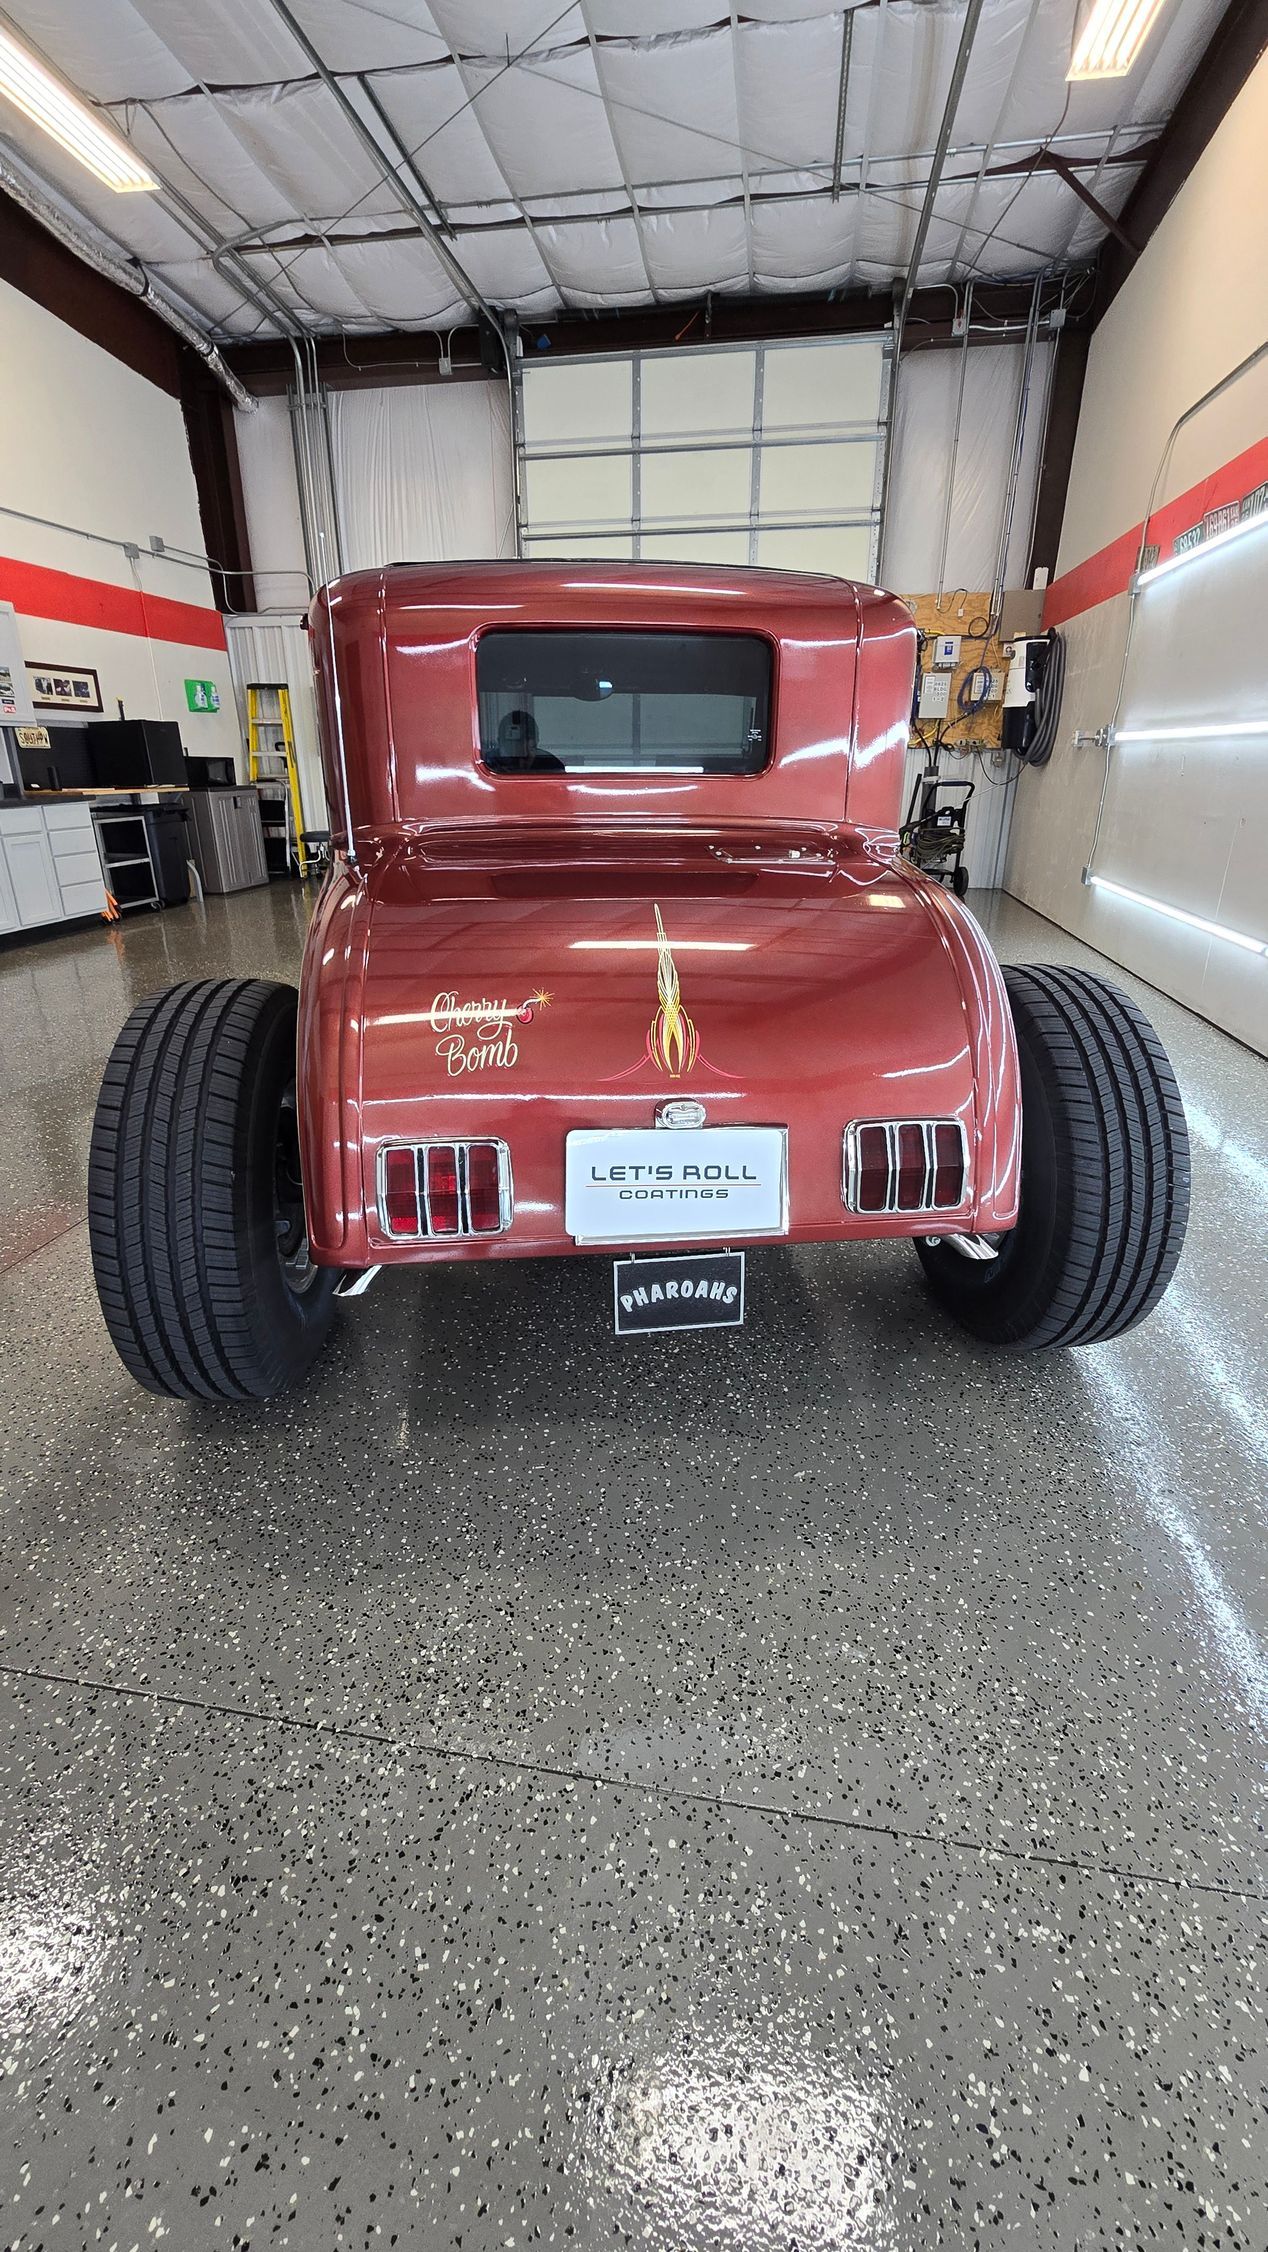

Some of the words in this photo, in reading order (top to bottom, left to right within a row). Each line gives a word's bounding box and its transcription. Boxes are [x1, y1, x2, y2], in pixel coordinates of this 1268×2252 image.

[430, 990, 513, 1041] Cherry
[435, 1028, 519, 1077] Bomb
[591, 1164, 673, 1181] LET'S
[682, 1164, 757, 1180] ROLL
[619, 1188, 729, 1200] COATINGS
[620, 1279, 739, 1313] PHAROAHS
